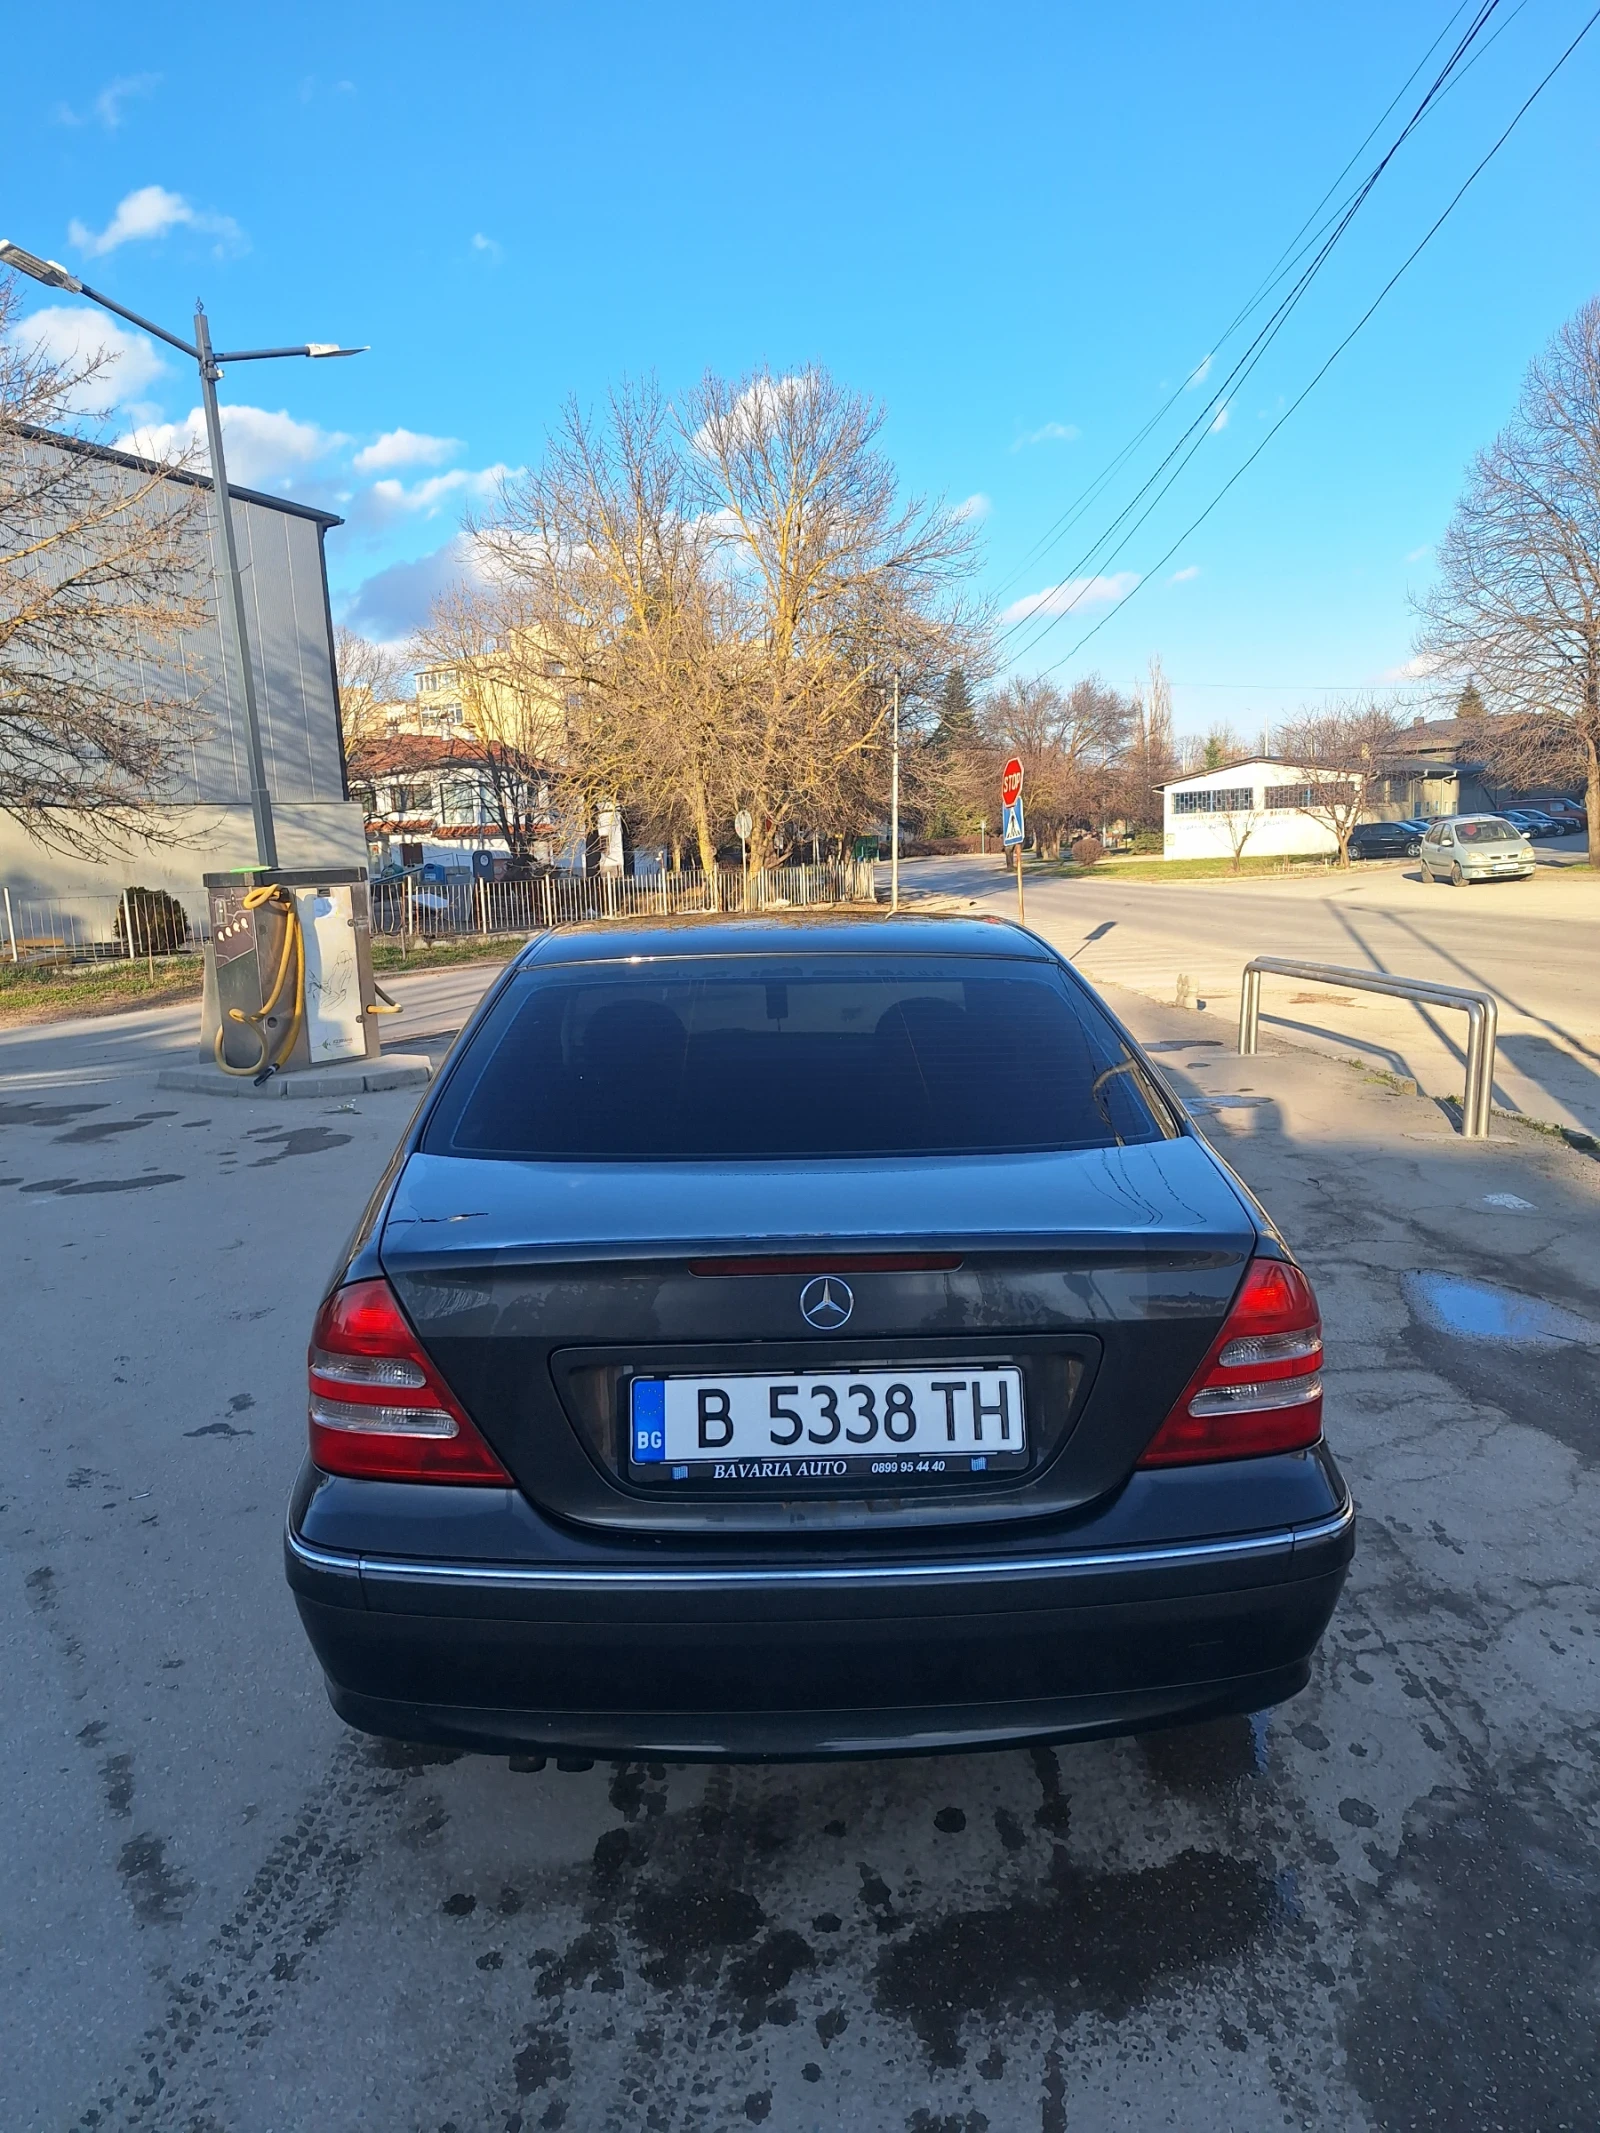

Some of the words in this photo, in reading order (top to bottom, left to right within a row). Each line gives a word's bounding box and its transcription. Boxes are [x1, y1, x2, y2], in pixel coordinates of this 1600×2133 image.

[1003, 773, 1020, 793] STOP
[697, 1388, 734, 1449] B
[769, 1384, 917, 1446] 5338
[931, 1380, 1010, 1441] TH
[637, 1431, 662, 1449] BG
[713, 1462, 794, 1479] BAVARIA
[796, 1460, 847, 1476] AUTO
[871, 1462, 897, 1474] 0899
[900, 1461, 914, 1473] 95
[915, 1460, 930, 1472] 44
[931, 1460, 946, 1472] 40
